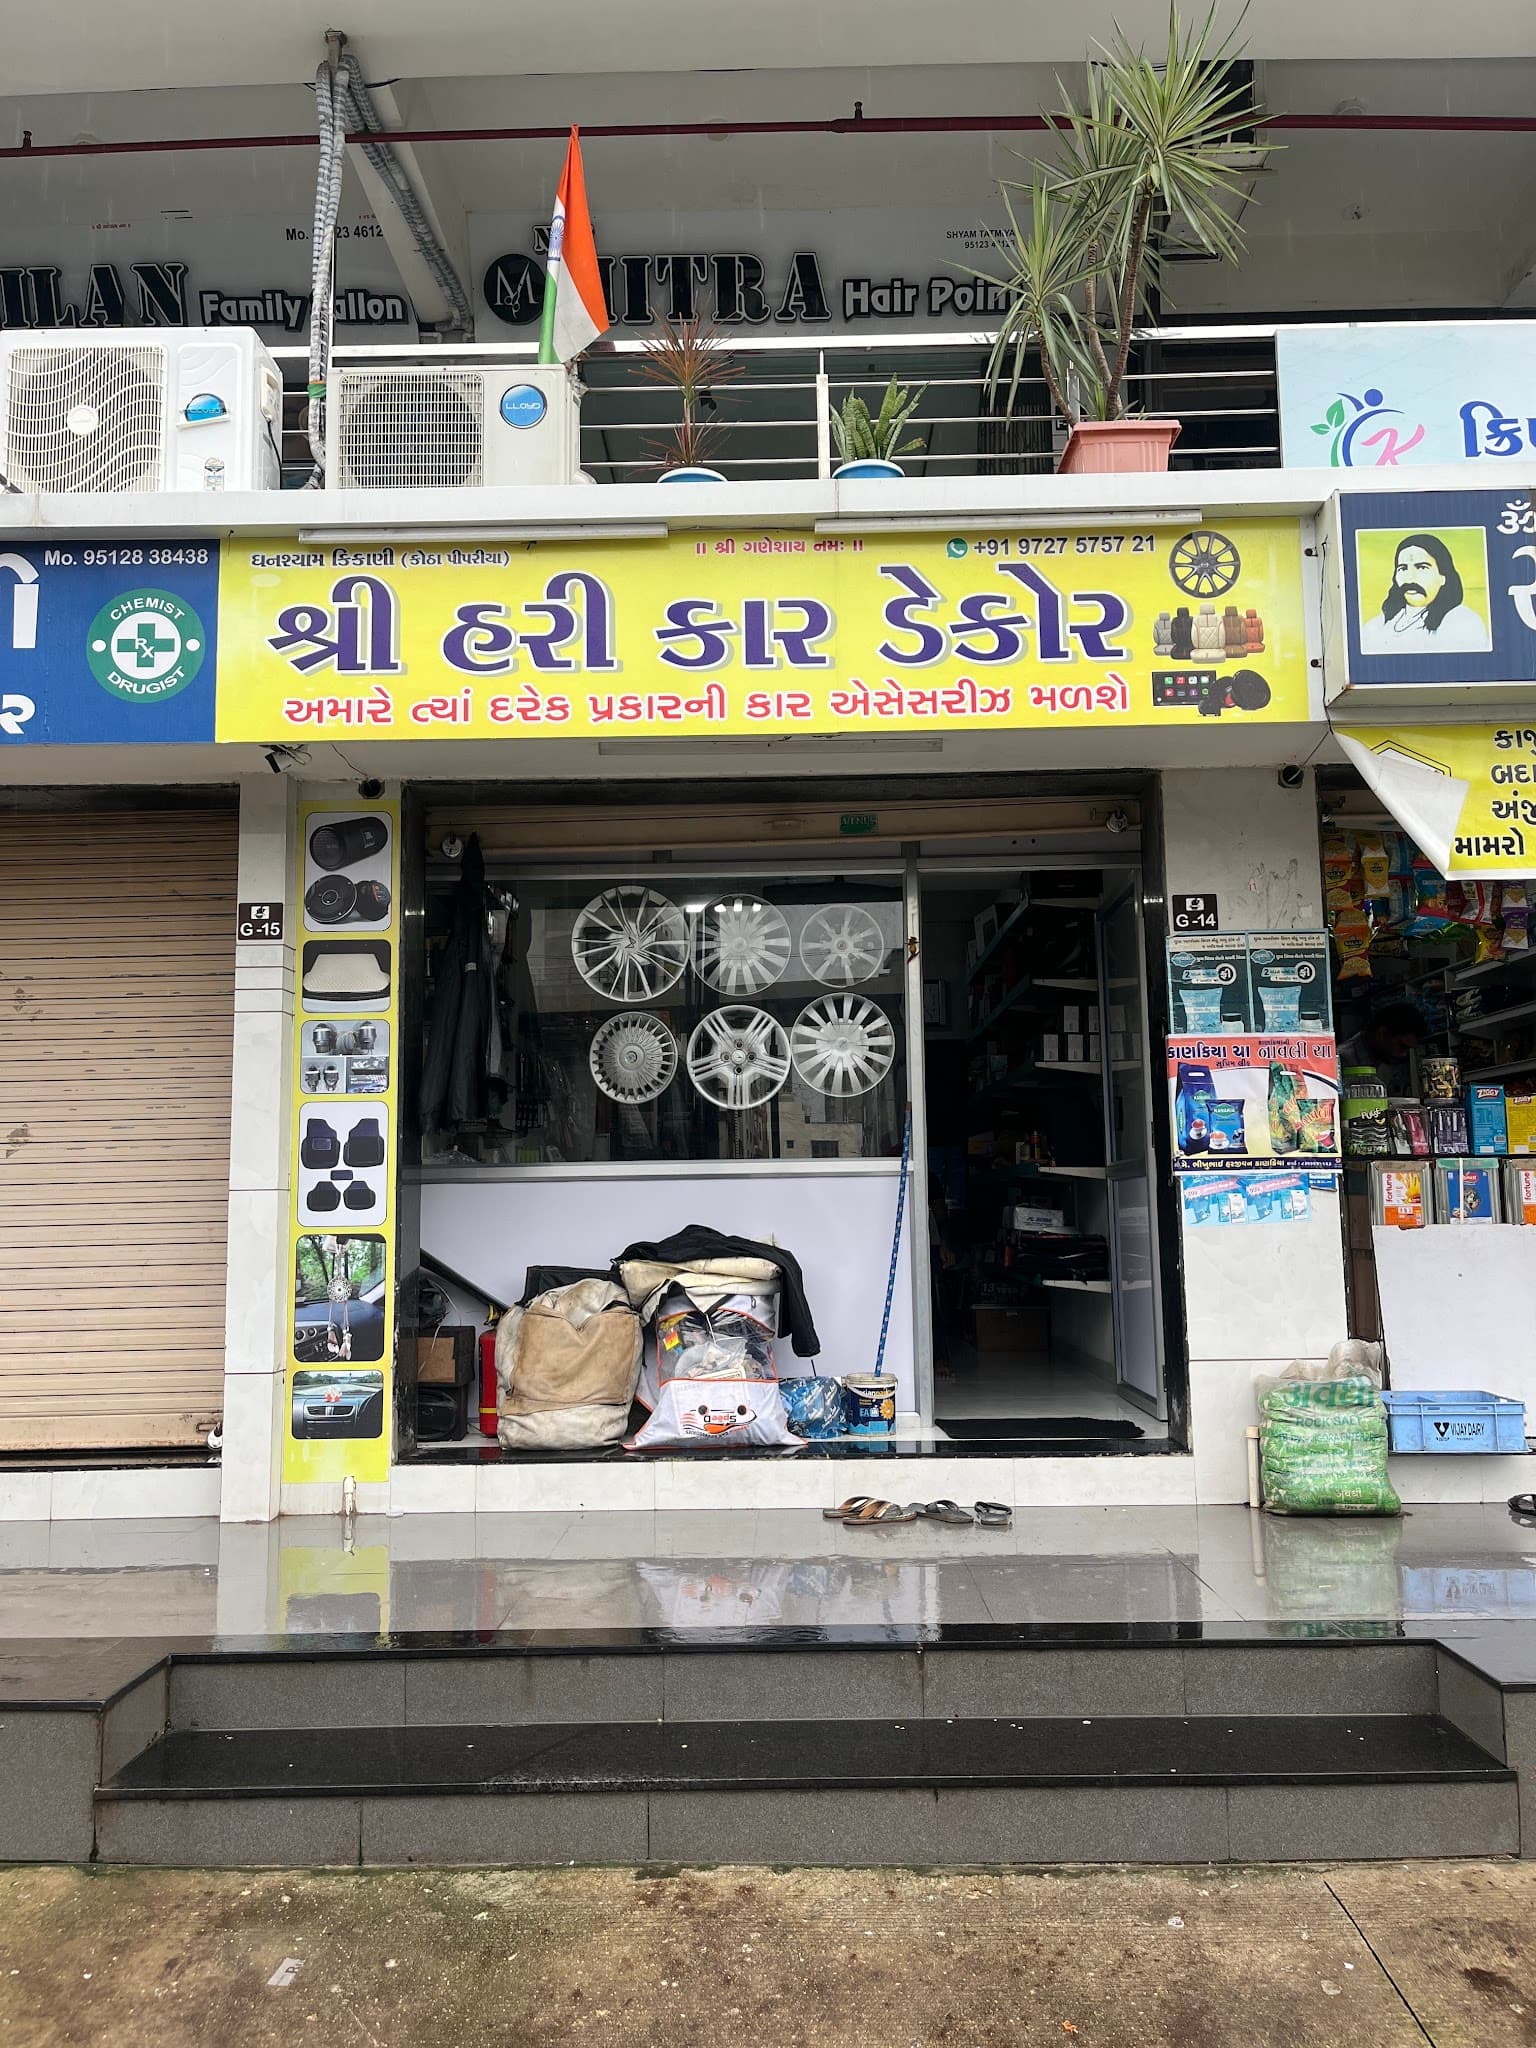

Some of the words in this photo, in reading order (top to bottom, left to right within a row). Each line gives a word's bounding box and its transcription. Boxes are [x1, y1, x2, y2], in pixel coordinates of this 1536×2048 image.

[285, 228, 309, 241] Mo.
[946, 230, 977, 239] SHYAM
[964, 240, 989, 249] 95123
[200, 290, 306, 331] Family
[334, 290, 407, 324] allon
[843, 279, 919, 322] Hair
[505, 402, 541, 410] LLOYD
[973, 538, 1010, 556] +91
[1018, 537, 1068, 555] 9727
[1075, 536, 1125, 554] 5757
[1132, 535, 1154, 552] 21
[44, 550, 77, 566] Mo.
[83, 549, 144, 566] 95128
[148, 548, 209, 565] 38438
[110, 597, 186, 621] CHEMIST
[268, 574, 400, 671] શ્રી
[442, 571, 614, 672] હરી
[656, 600, 829, 667] કાર
[878, 563, 1126, 664] ડેકોર
[106, 666, 186, 695] DRUGIST
[285, 688, 392, 723] અમારે
[411, 688, 470, 723] ત્યાં
[490, 685, 570, 722] દરેક
[589, 683, 725, 722] પ્રકારની
[747, 693, 811, 719] કાર
[831, 679, 1011, 716] એસેસરીઝ
[1031, 674, 1128, 712] મળશે
[1455, 827, 1525, 857] મામરો
[240, 922, 280, 936] G-15
[1175, 913, 1216, 928] G-14
[1477, 1088, 1499, 1099] ZIGGY
[1385, 1173, 1393, 1203] fortune
